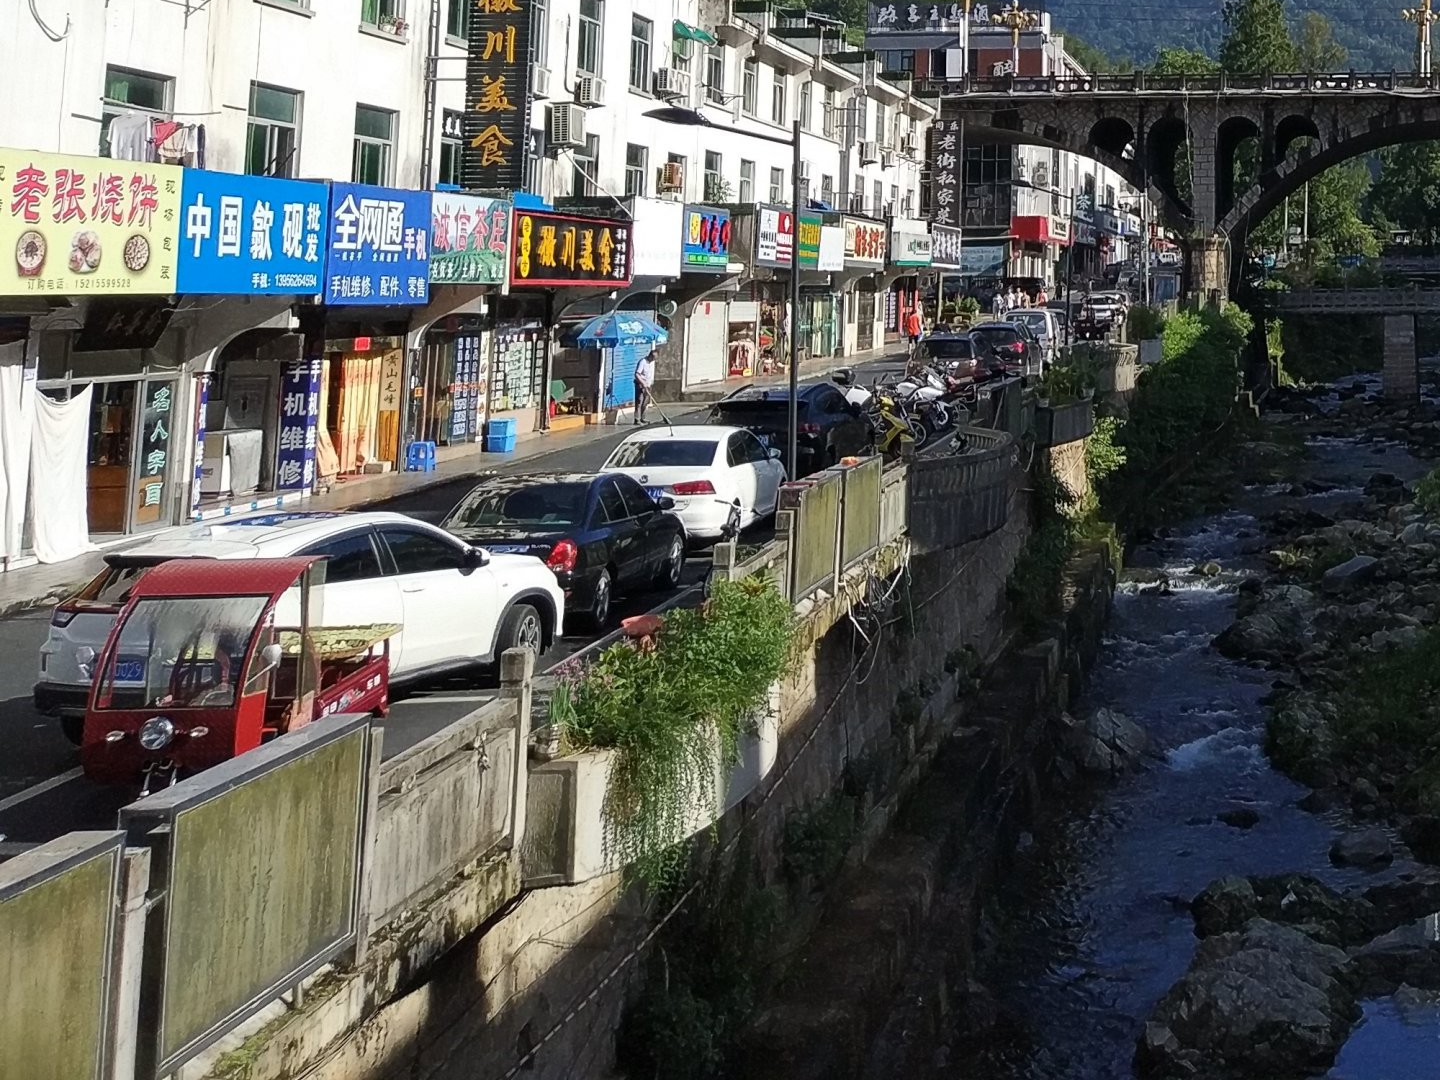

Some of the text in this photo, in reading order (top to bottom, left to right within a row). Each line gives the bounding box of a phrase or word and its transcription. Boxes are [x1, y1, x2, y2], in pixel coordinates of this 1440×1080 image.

[11, 163, 160, 232] 老张烧饼
[935, 134, 957, 225] 老街私家菜
[186, 192, 322, 263] 中国歙砚 批发
[332, 193, 427, 261] 全网通 手机
[433, 202, 507, 252] 诚信茶庄
[278, 359, 309, 486] 手机维修
